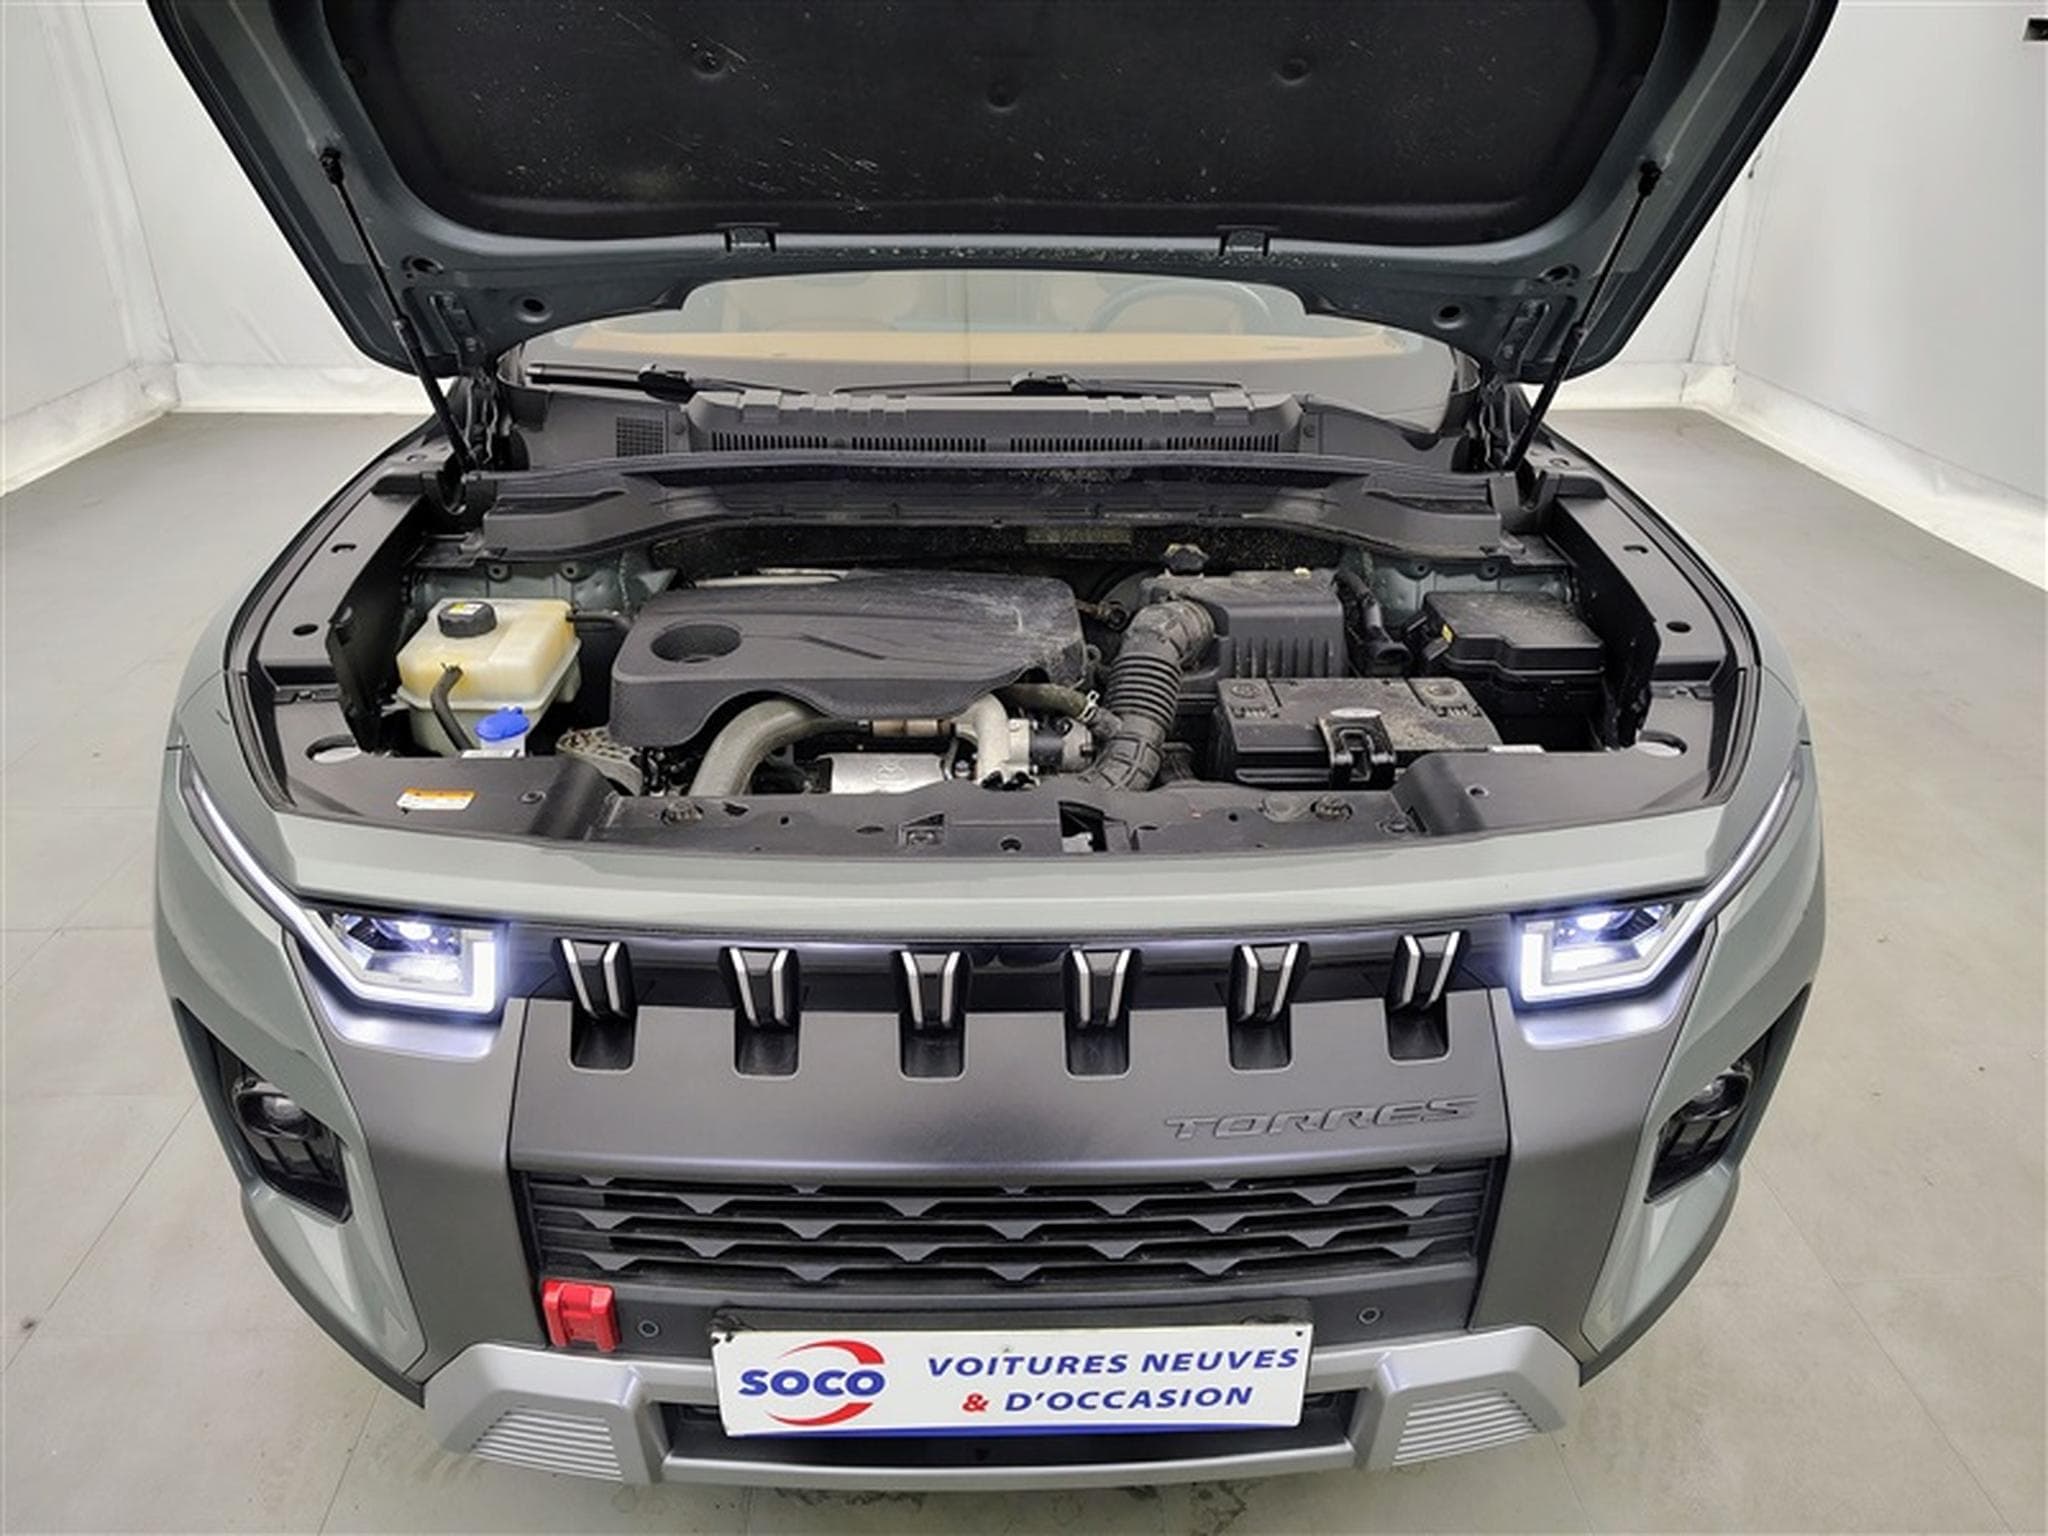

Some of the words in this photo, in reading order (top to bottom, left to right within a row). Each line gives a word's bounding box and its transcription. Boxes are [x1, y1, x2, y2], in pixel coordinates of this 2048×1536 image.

[1165, 1097, 1478, 1139] TORRES
[929, 1355, 1128, 1376] VOITURES
[1141, 1349, 1299, 1373] NEUVES
[739, 1370, 885, 1396] SOCO
[963, 1393, 989, 1412] &
[1005, 1387, 1253, 1412] D'OCCASION
